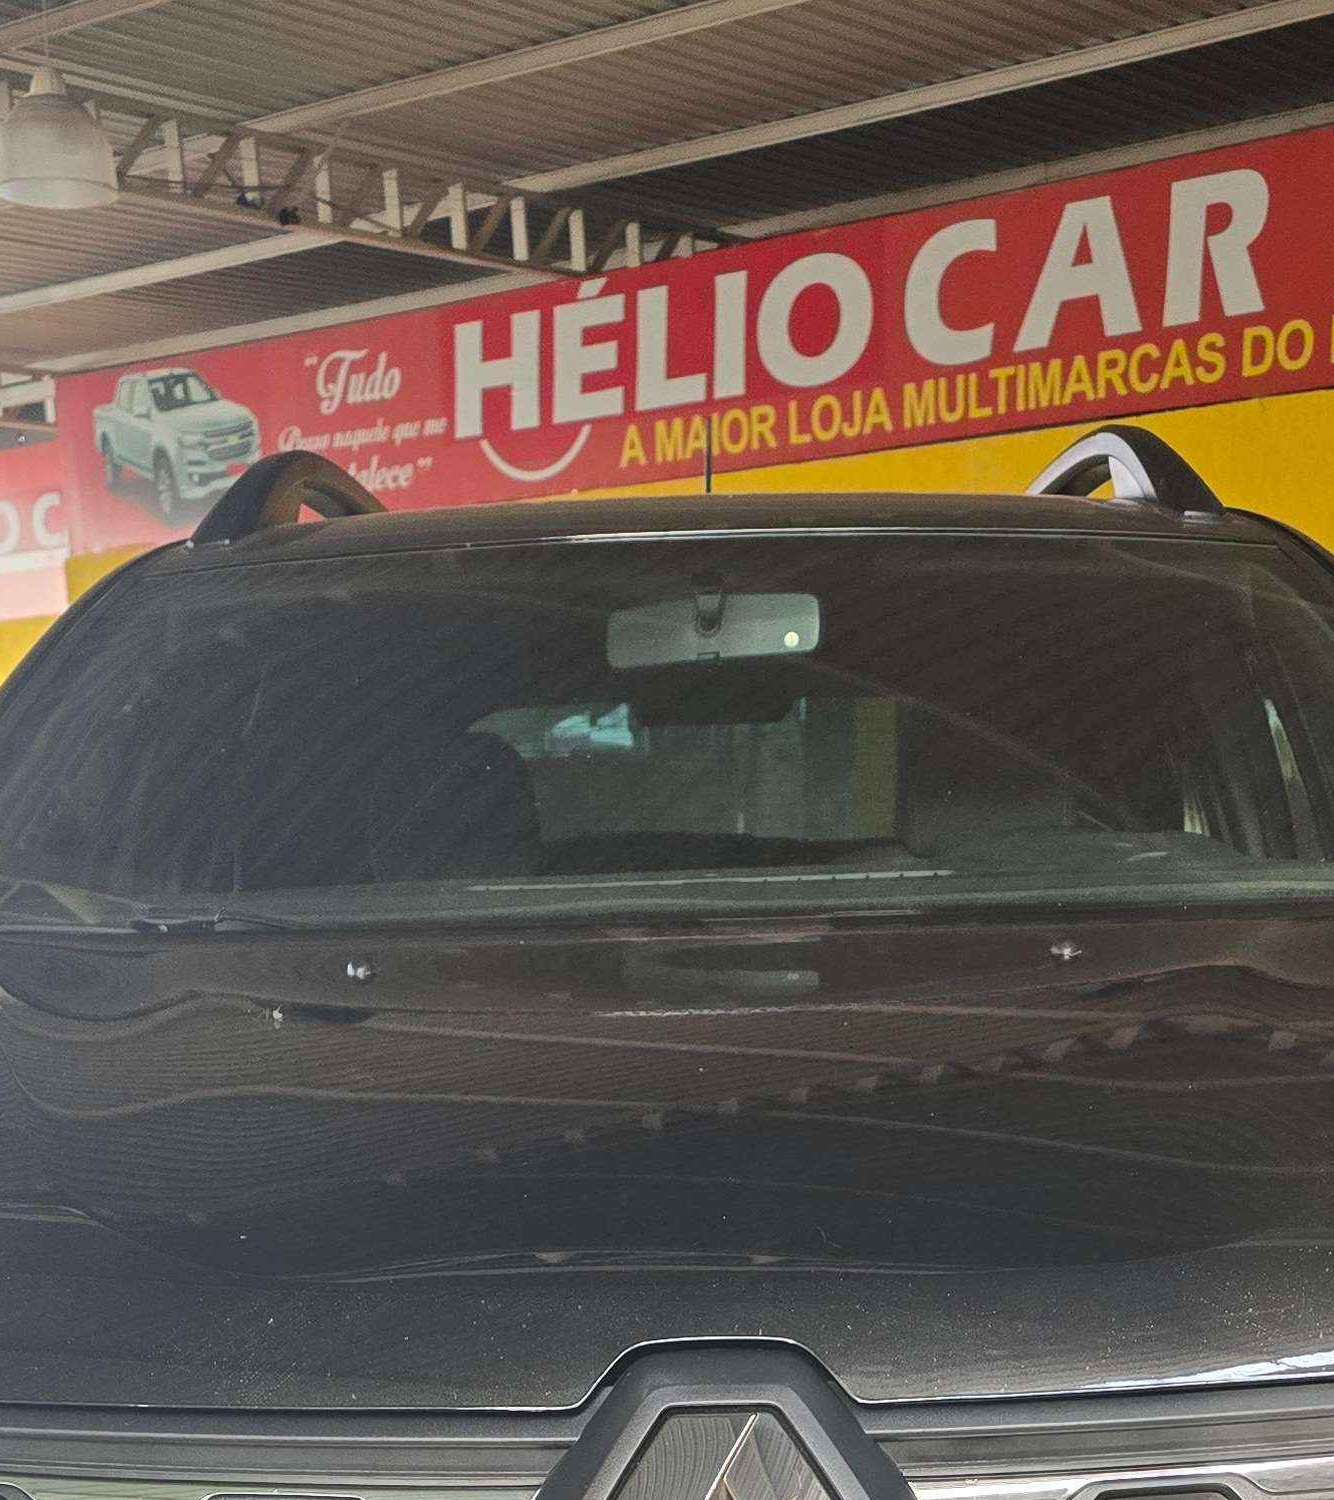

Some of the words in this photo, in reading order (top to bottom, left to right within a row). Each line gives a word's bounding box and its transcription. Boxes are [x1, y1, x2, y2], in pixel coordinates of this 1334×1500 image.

[454, 277, 873, 440] HÉLIO
[904, 168, 1269, 365] CAR
[620, 424, 646, 468] A
[655, 405, 777, 464] MAIOR
[788, 383, 893, 446] LOJA
[903, 332, 1227, 429] MULTIMARCAS
[1241, 319, 1315, 377] DO
